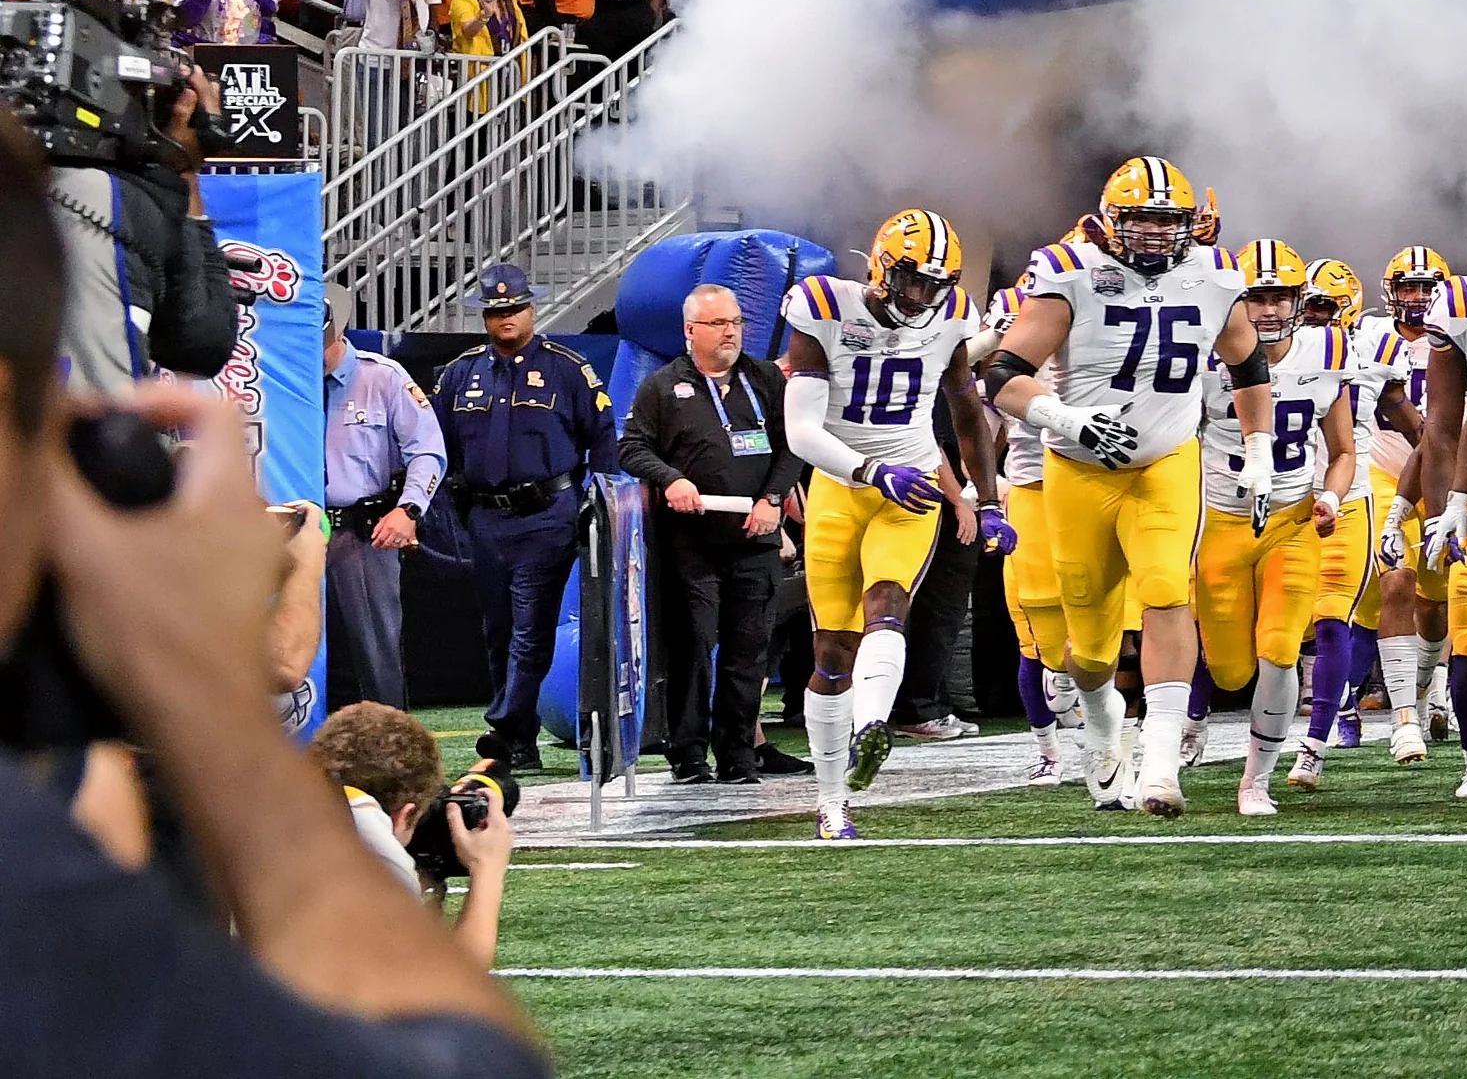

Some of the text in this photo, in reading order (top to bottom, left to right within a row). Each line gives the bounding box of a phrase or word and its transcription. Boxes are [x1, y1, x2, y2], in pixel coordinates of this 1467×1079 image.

[225, 95, 279, 108] PECIAL
[1143, 296, 1164, 304] LSU
[1103, 305, 1202, 394] 76
[841, 355, 924, 425] 10
